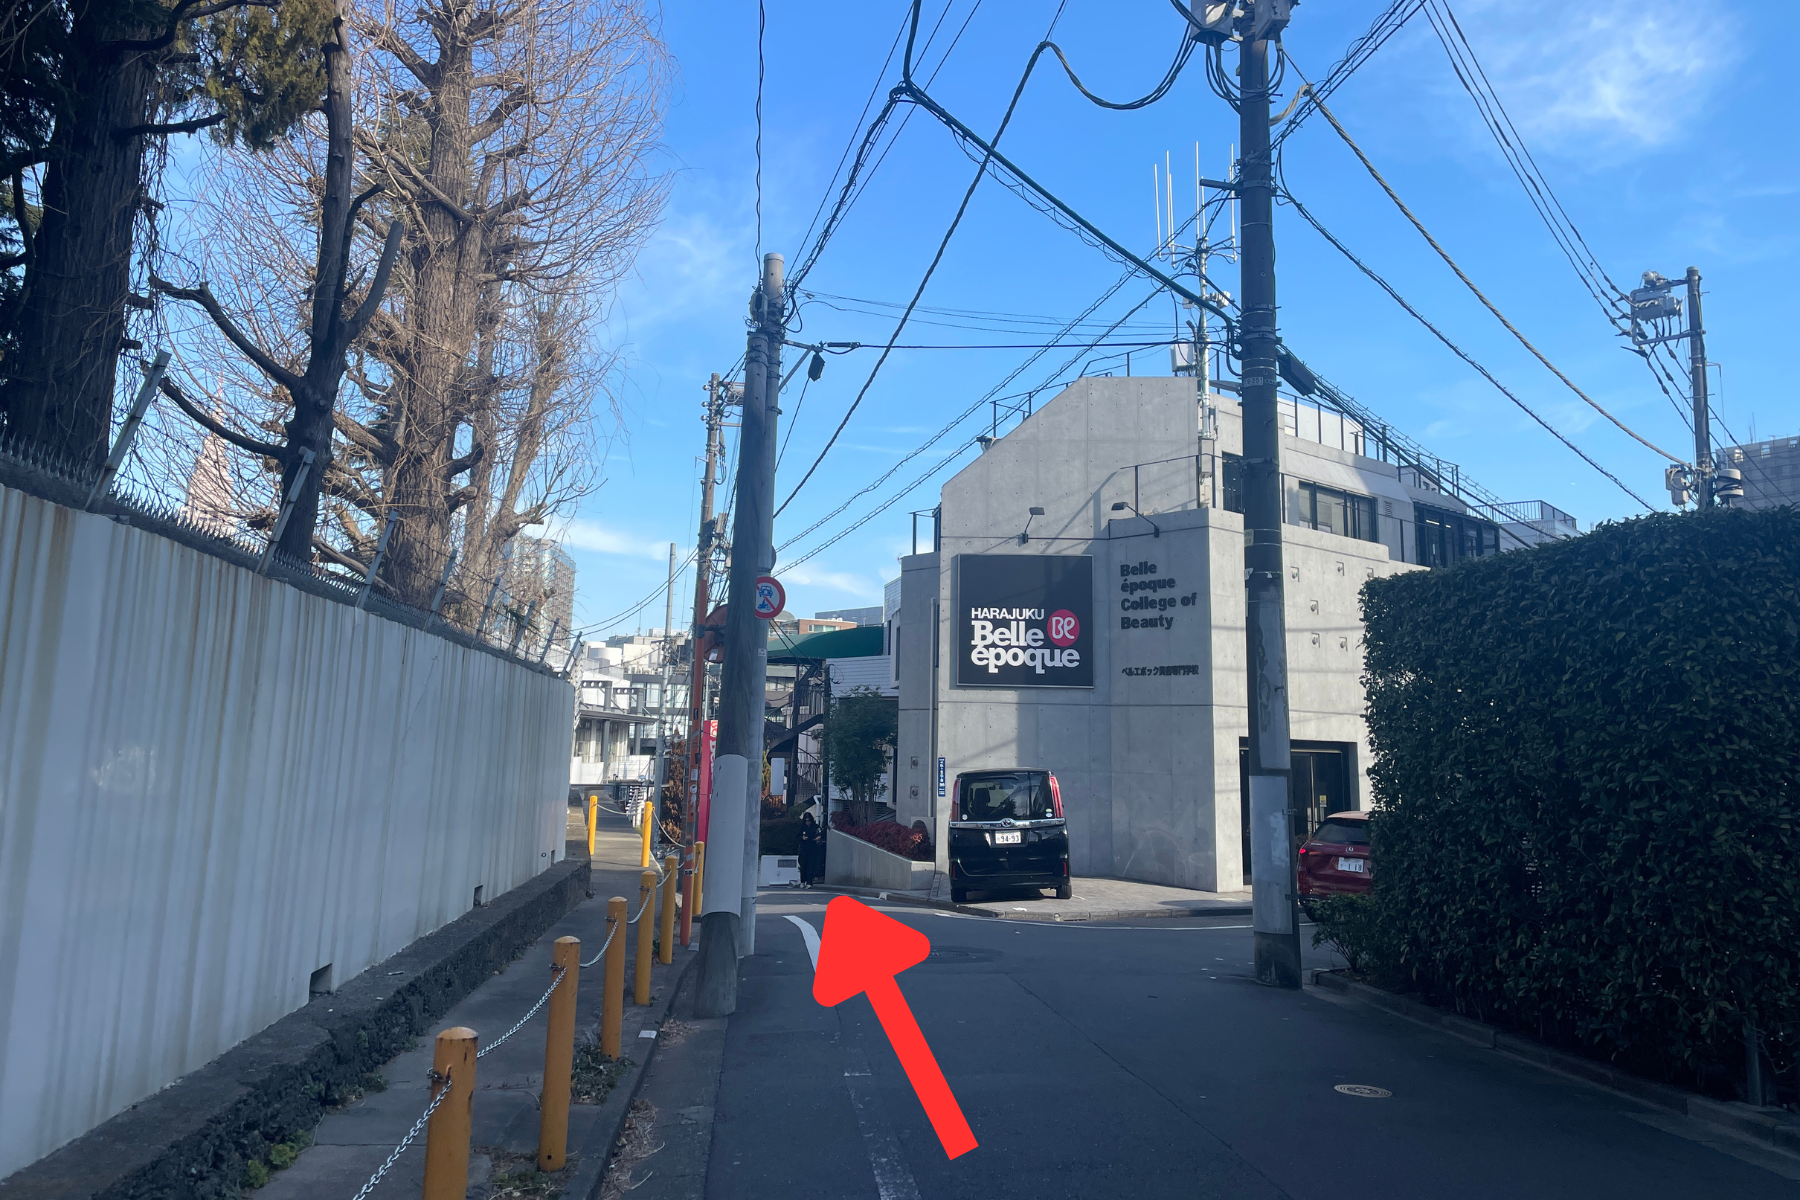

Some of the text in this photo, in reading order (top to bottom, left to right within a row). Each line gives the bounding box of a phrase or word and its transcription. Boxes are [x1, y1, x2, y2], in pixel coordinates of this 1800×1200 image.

[1120, 561, 1157, 577] Belle
[1121, 578, 1176, 595] époque
[1121, 592, 1198, 612] College of
[971, 607, 1044, 620] HARAJUKU
[1121, 614, 1174, 630] Beauty
[971, 620, 1044, 647] Belle
[971, 645, 1080, 674] époque
